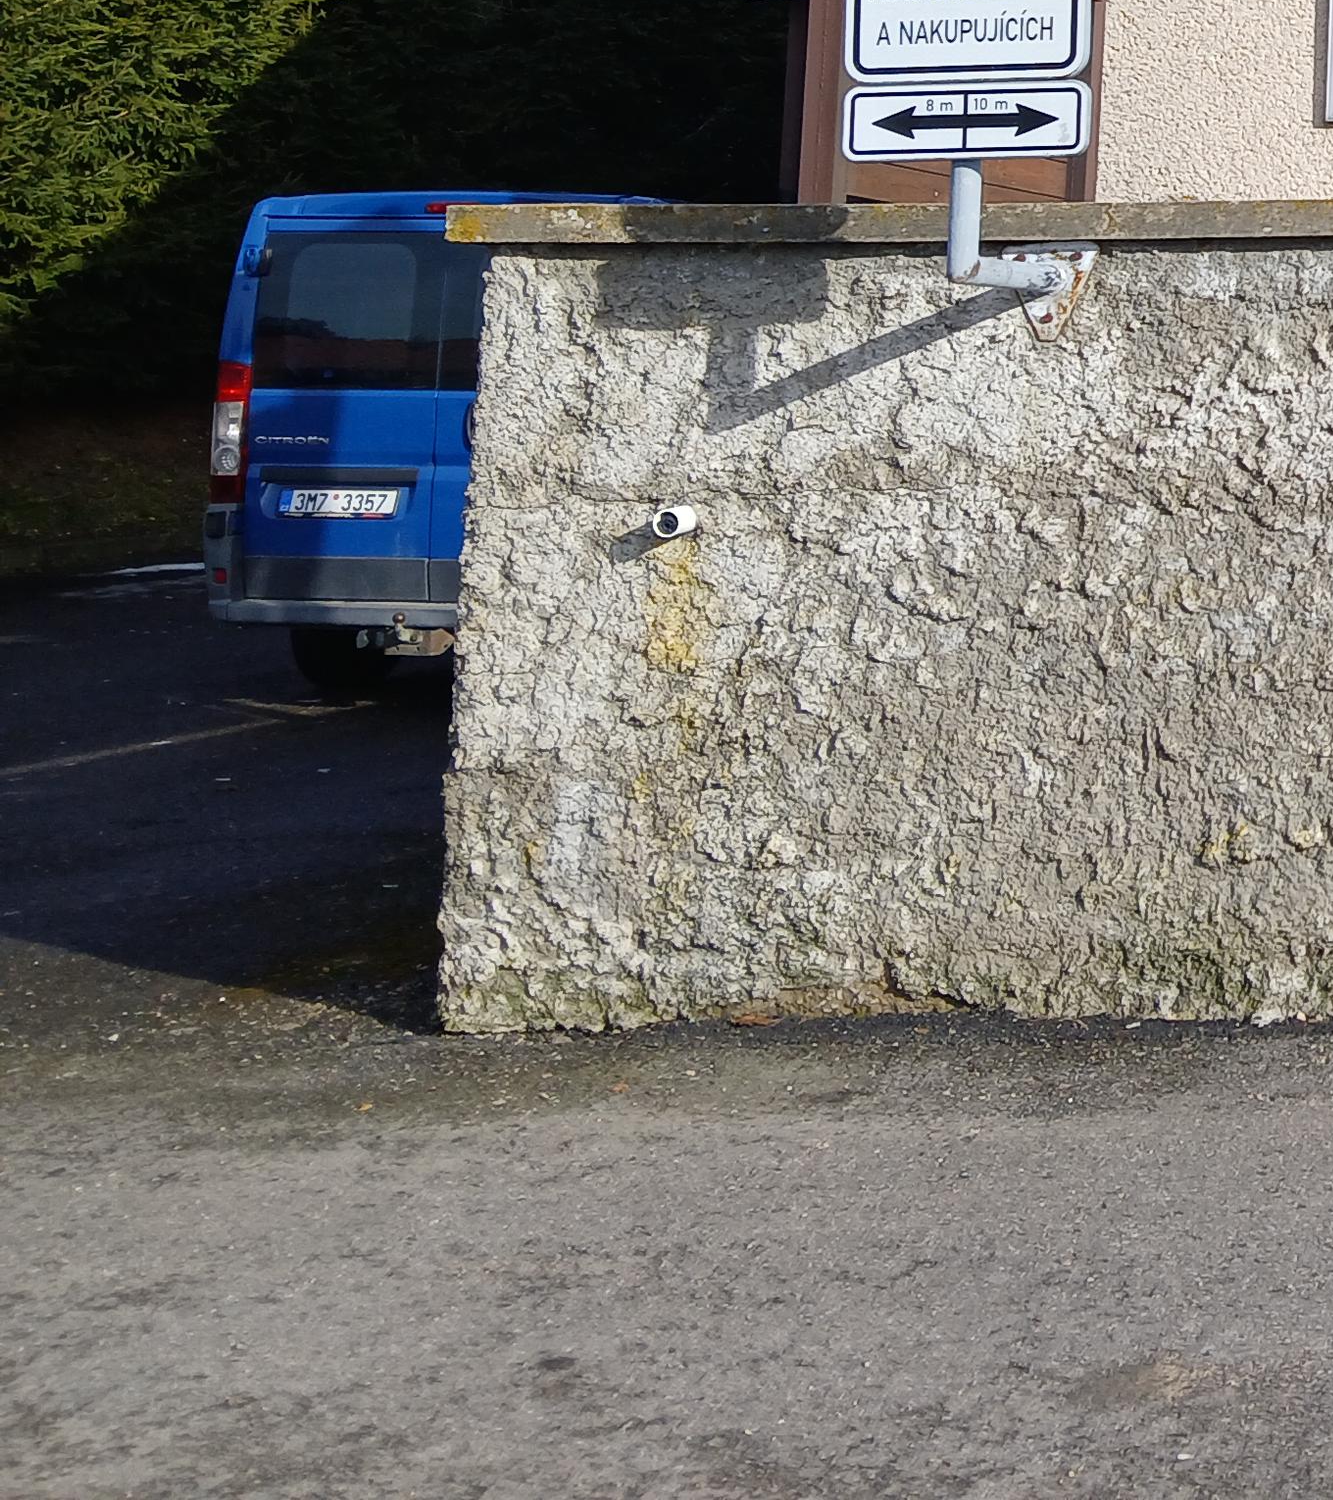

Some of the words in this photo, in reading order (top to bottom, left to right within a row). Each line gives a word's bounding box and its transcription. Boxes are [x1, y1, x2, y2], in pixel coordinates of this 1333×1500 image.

[876, 22, 891, 46] A
[900, 10, 1054, 45] NAKUPUJÍCÍCH
[926, 100, 934, 112] 8
[939, 102, 953, 111] m
[974, 98, 988, 111] 10
[994, 100, 1008, 110] m
[295, 493, 328, 511] 3M7
[341, 494, 388, 512] 3357
